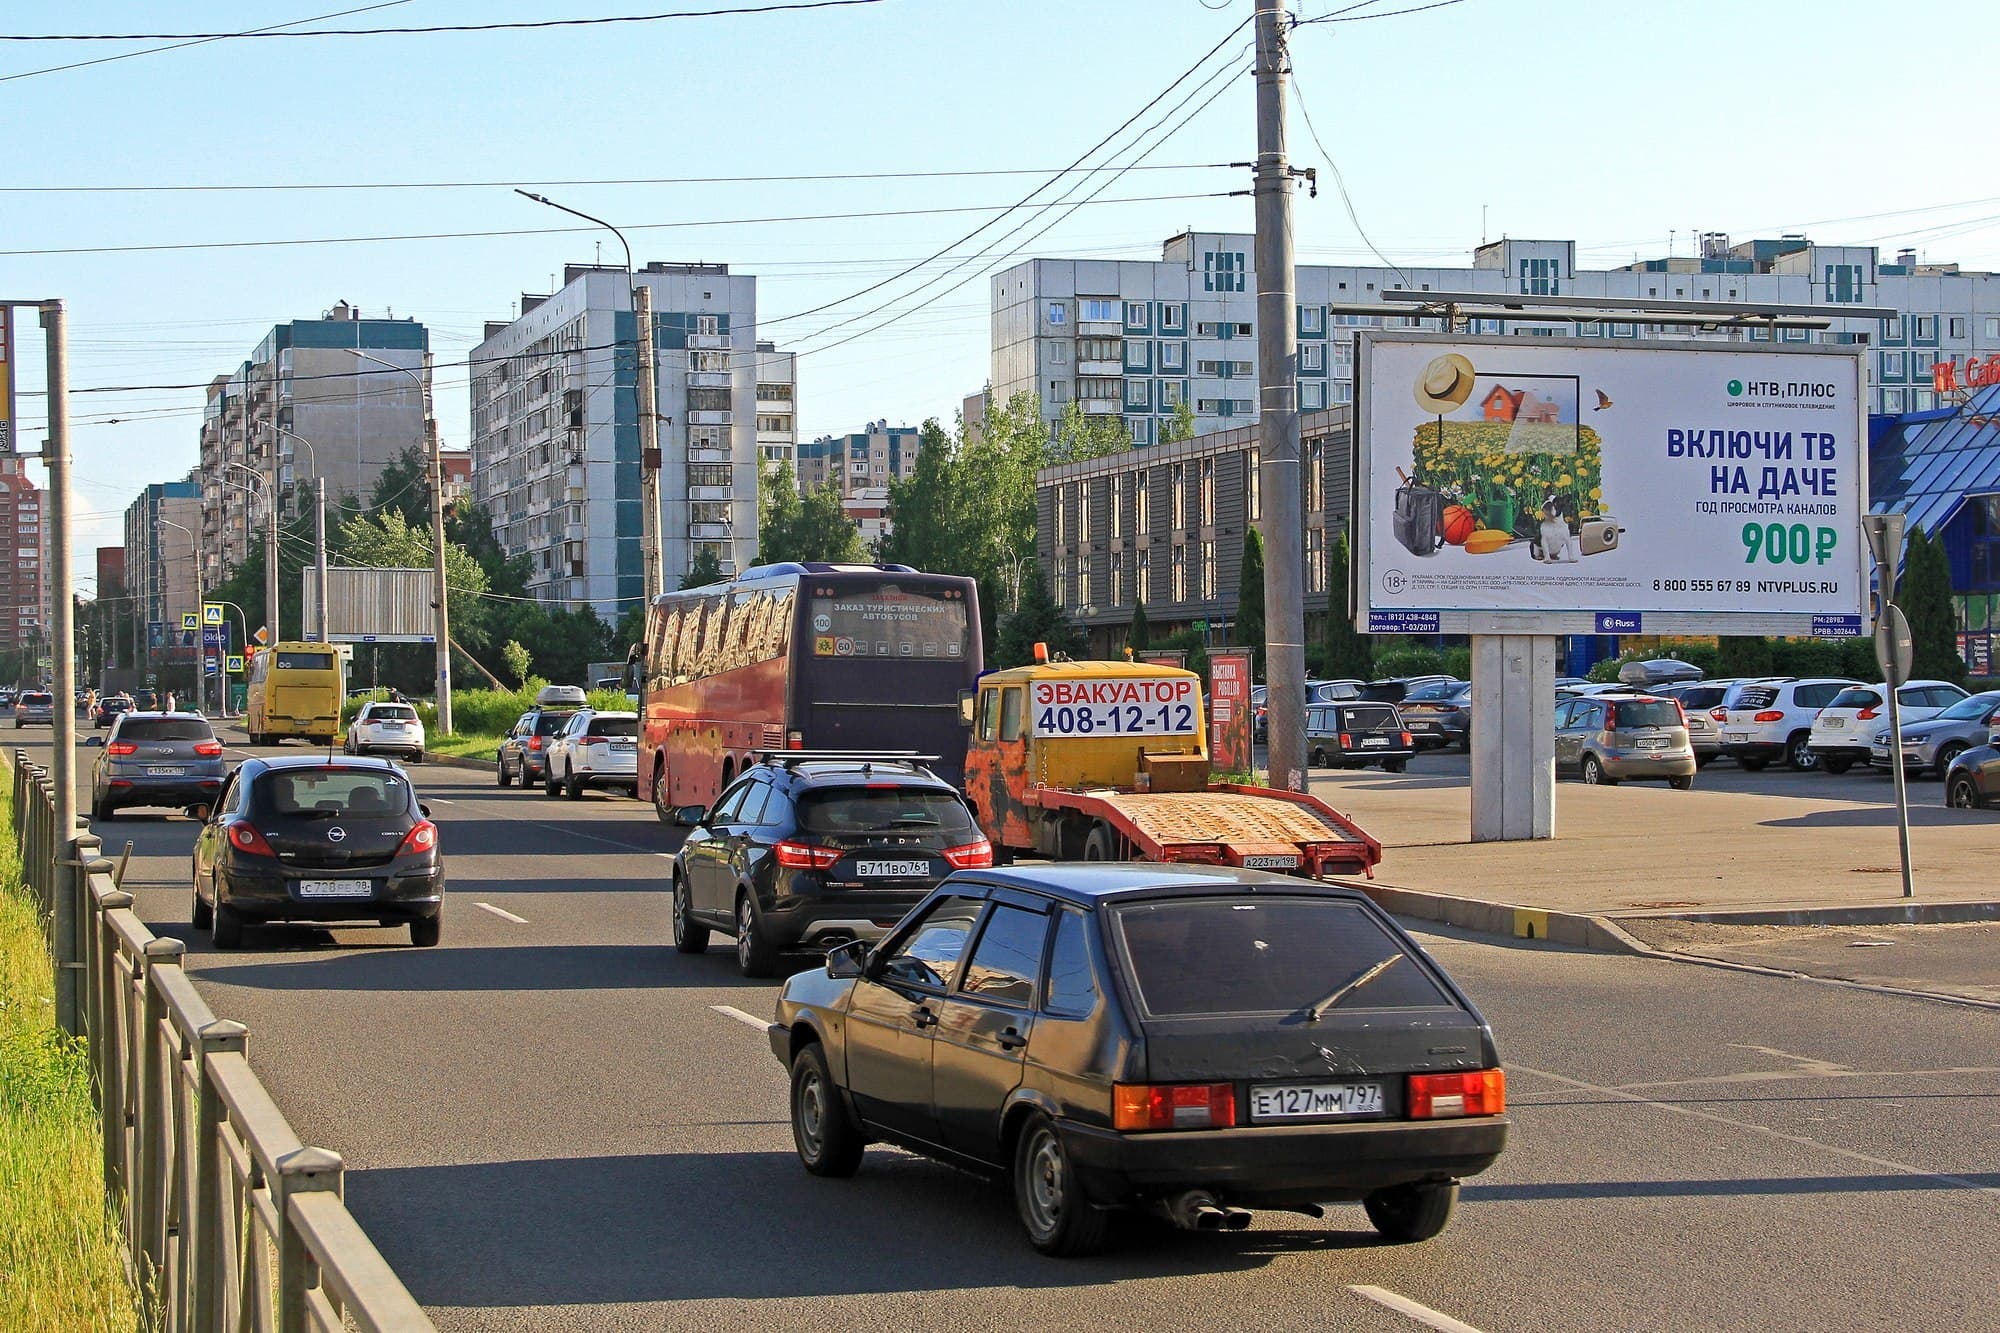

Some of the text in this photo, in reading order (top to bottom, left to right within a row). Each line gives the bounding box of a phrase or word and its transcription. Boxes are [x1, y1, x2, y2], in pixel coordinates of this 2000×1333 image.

[1667, 429, 1836, 461] ВКЛЮЧИ ТВ
[1711, 465, 1837, 500] НА ДАЧЕ
[1696, 501, 1837, 516] ГОД ПРОСМОТРА КАНАЛОВ
[1387, 576, 1408, 588] 18+
[1652, 579, 1751, 592] 8 800 555 67 89
[1757, 580, 1838, 594] NTVPLUS.RU
[834, 603, 945, 613] ЗАКАЗ ТУРИСТИЧЕСКИХ
[815, 618, 830, 628] 100
[862, 612, 918, 621] АВТОБУСОВ
[1615, 619, 1635, 628] Russ
[838, 642, 850, 651] 60
[1036, 681, 1191, 705] ЭВАКУАТОР
[1038, 704, 1193, 734] 408-12-12
